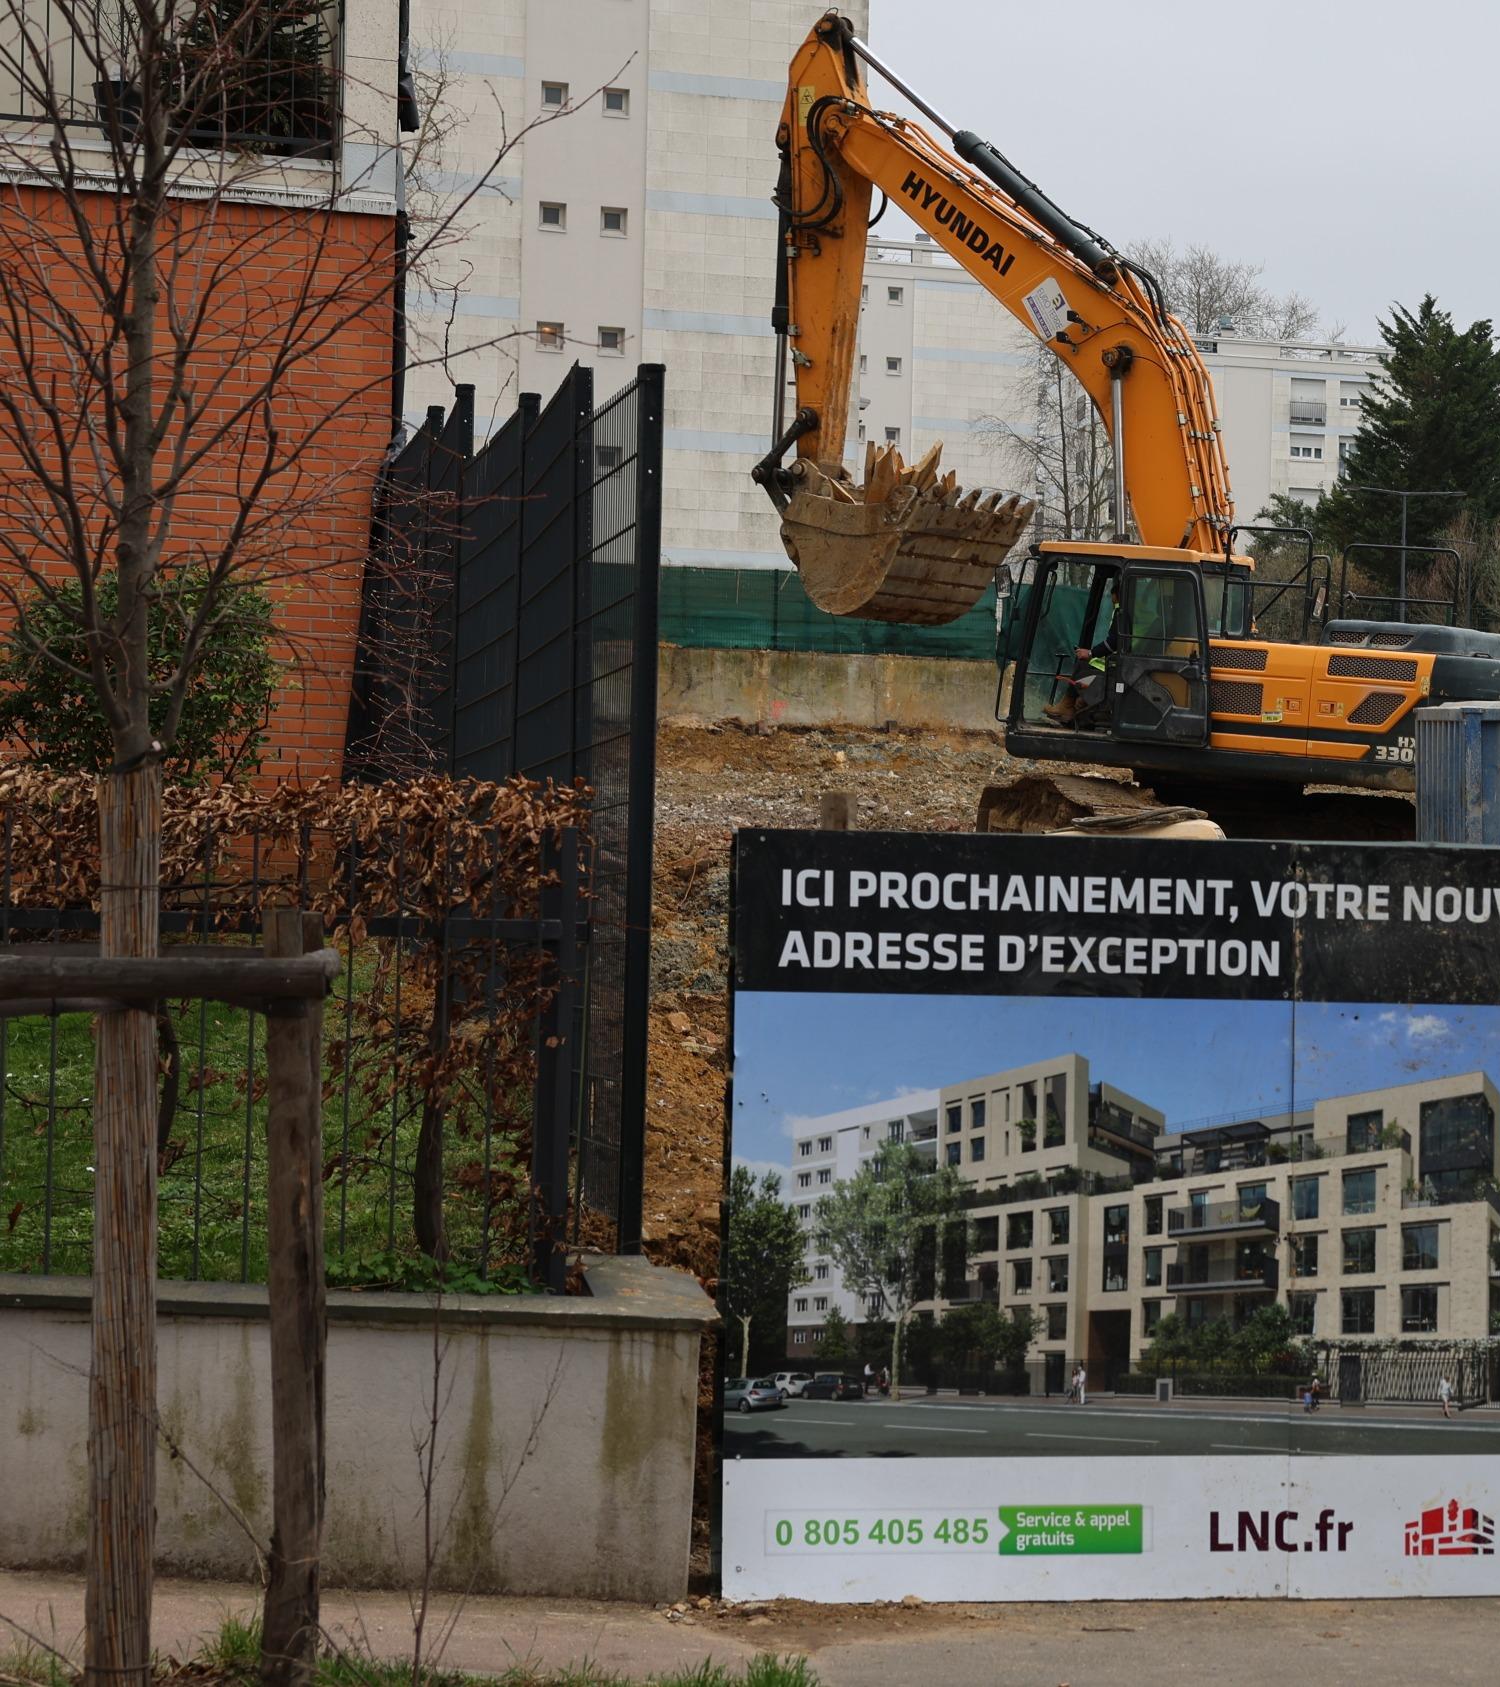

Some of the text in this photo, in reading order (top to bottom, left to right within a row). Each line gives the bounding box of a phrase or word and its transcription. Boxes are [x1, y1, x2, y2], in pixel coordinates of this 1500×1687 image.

[901, 170, 1016, 277] HYUNDAI
[1375, 745, 1416, 763] 330
[780, 868, 835, 908] ICI
[849, 870, 1240, 924] PROCHAINEMENT,
[1250, 879, 1391, 921] VOTRE
[777, 930, 985, 971] ADRESSE
[775, 1517, 989, 1546] 0 805 405 485
[1016, 1509, 1131, 1532] Service & appel
[1209, 1508, 1354, 1553] LNC.fr
[1016, 1531, 1076, 1552] gratuits
